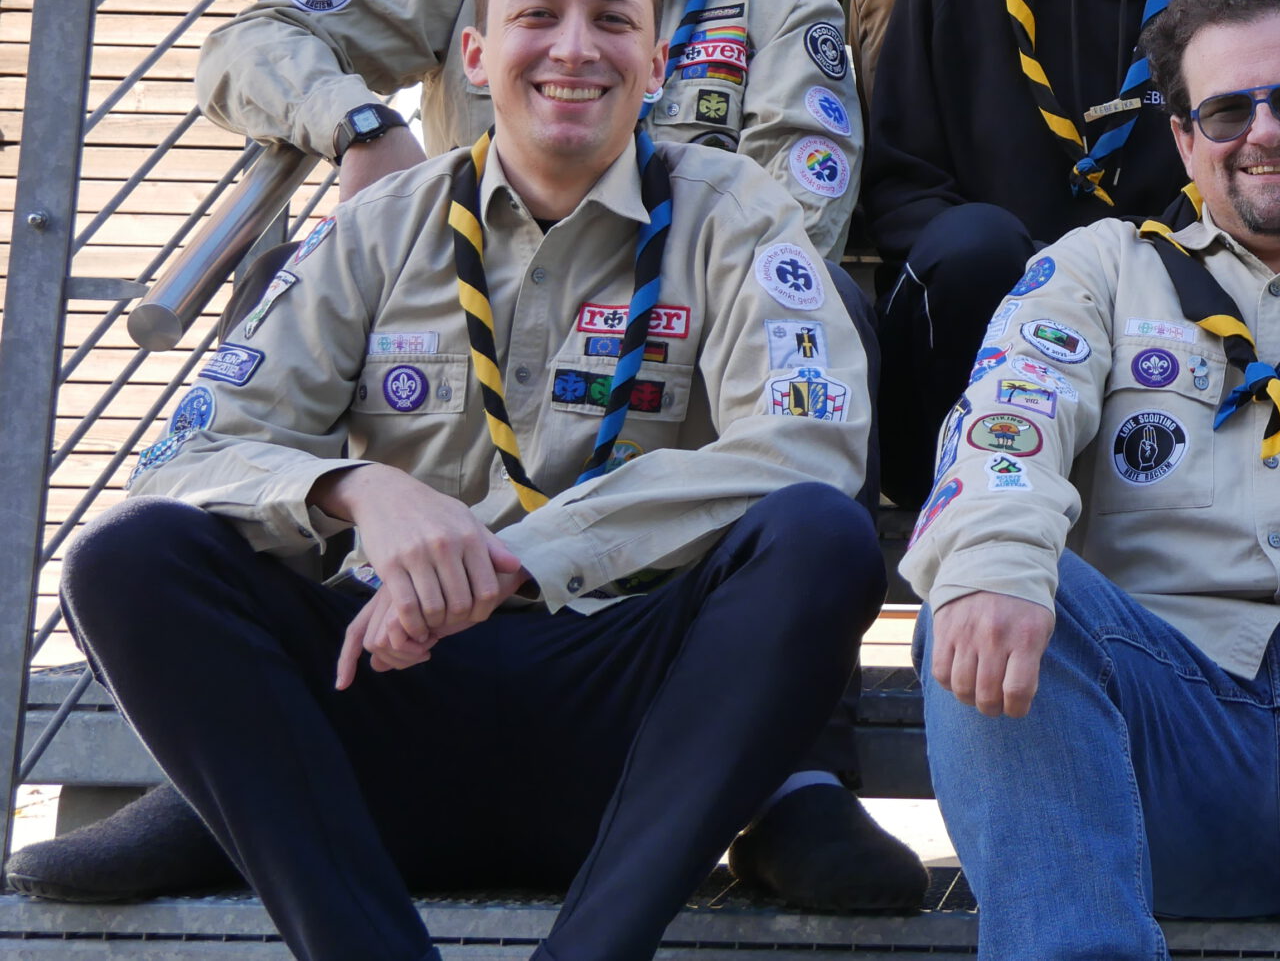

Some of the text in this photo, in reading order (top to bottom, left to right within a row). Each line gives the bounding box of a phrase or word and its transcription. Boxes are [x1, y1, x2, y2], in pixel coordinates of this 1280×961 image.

[815, 52, 834, 72] SINCE
[774, 285, 797, 302] sankt
[990, 415, 1025, 425] VIKING
[1120, 414, 1177, 437] LOVE SCOUTING
[1124, 462, 1174, 480] HATE RACISM
